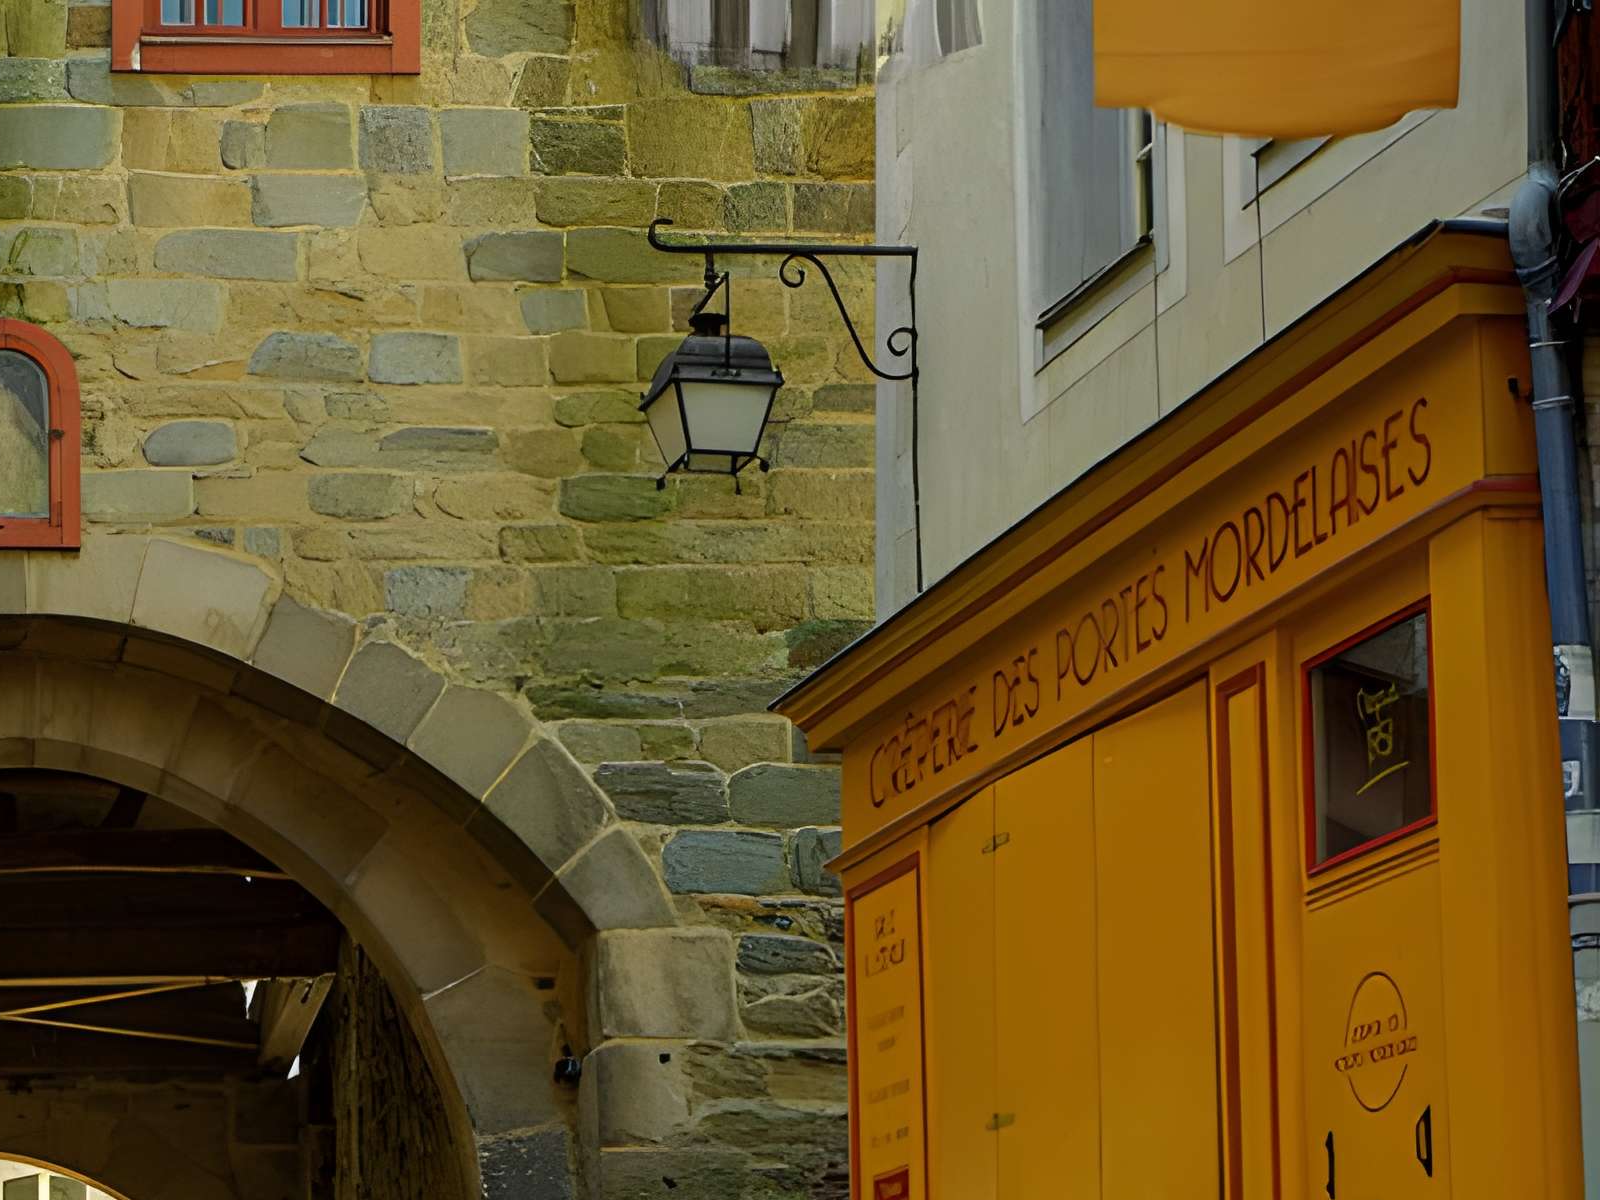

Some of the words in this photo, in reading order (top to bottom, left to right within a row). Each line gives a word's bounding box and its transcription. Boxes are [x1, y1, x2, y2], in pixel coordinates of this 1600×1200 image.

[993, 647, 1040, 738] DES
[1056, 564, 1168, 702] PORTES
[1184, 397, 1431, 623] MORDELAISES
